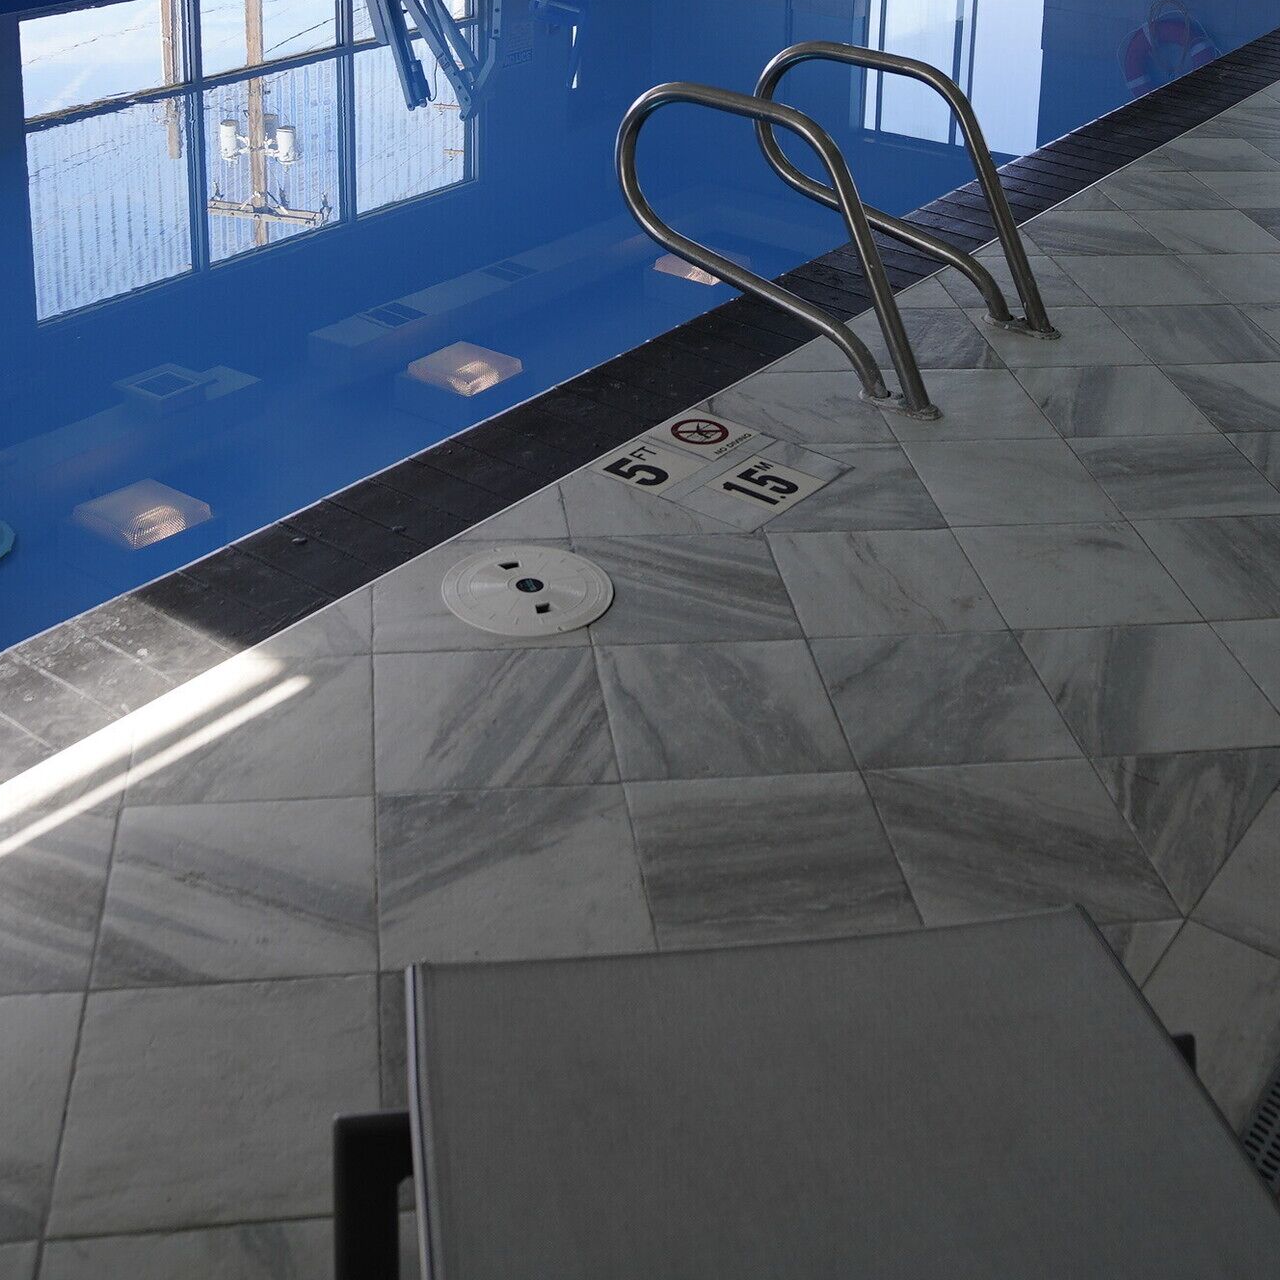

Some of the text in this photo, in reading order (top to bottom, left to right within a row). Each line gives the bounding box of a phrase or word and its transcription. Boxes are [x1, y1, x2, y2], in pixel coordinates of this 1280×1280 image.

[713, 432, 752, 455] NO DIVING
[602, 446, 670, 486] 5 FT
[722, 461, 799, 506] 1.5 M
